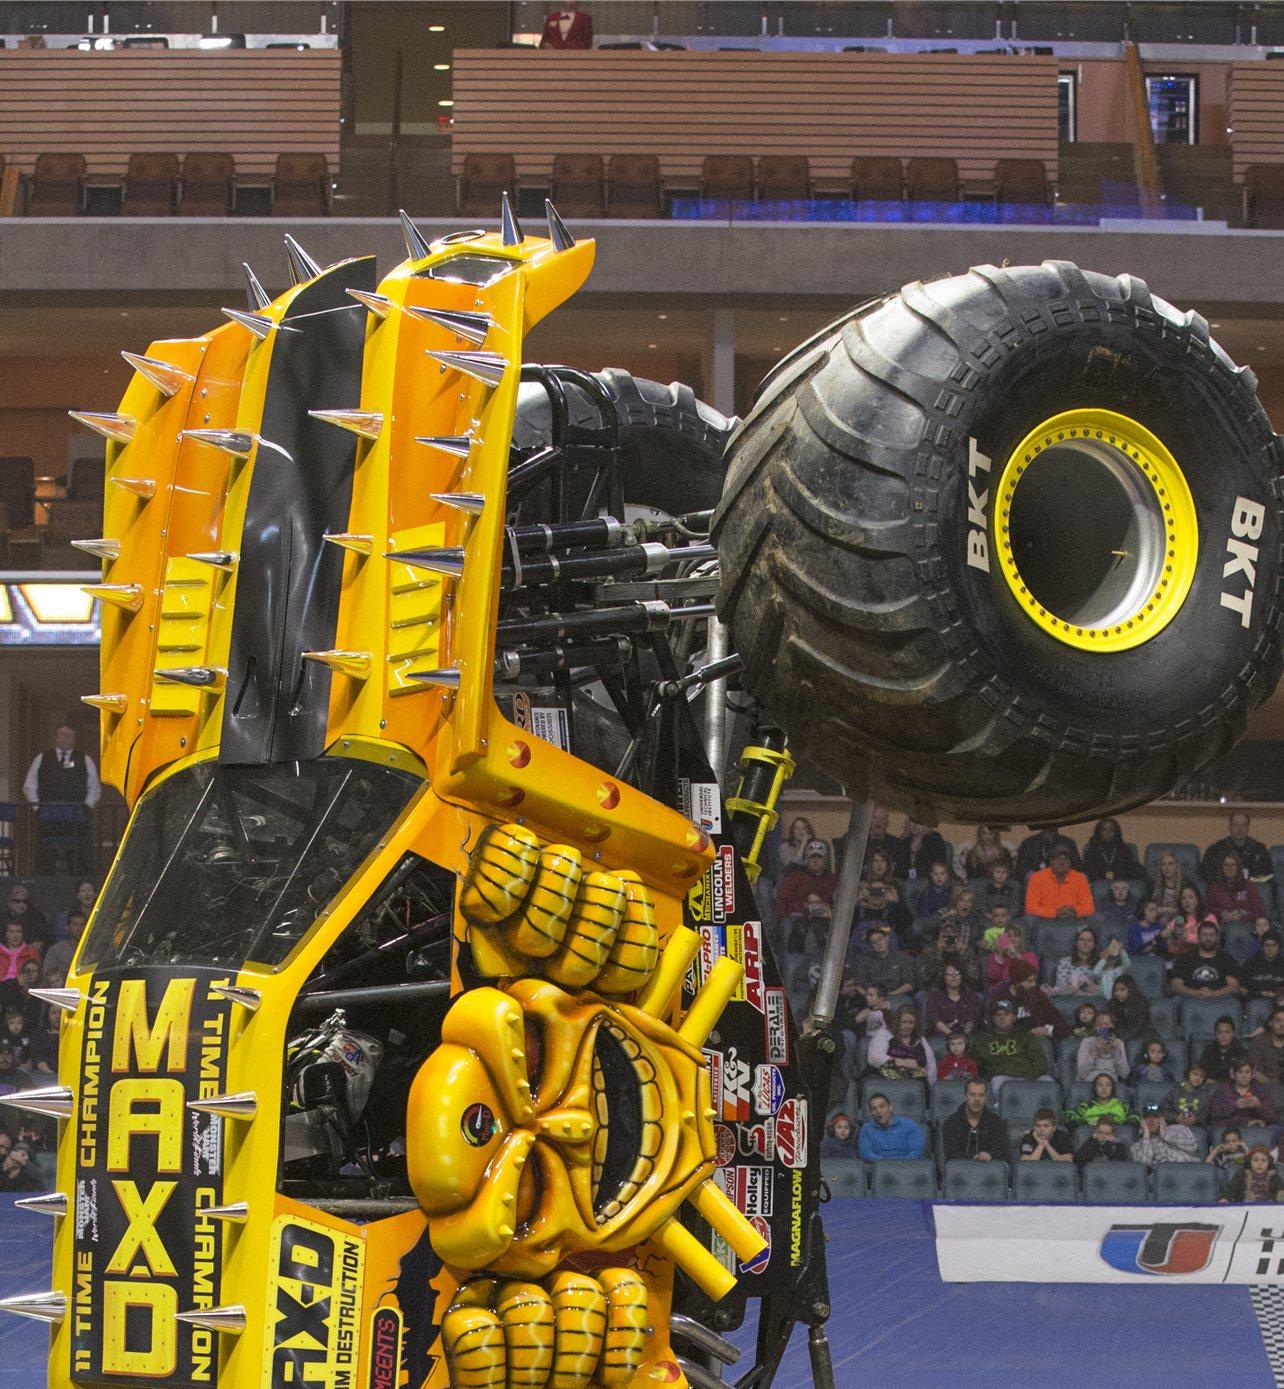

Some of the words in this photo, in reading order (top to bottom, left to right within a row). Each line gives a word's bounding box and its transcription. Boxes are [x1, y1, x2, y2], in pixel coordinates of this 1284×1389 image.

[966, 436, 992, 573] BKT
[1220, 495, 1266, 630] BKT
[703, 873, 711, 921] MECHANIX
[714, 859, 724, 920] LINCOLN
[724, 853, 732, 906] WELDERS
[207, 977, 231, 1000] 11
[743, 922, 762, 1010] ARP
[200, 1013, 224, 1100] TIME
[768, 995, 780, 1059] DERALE
[80, 980, 110, 1168] CHAMPION
[762, 1069, 770, 1108] LUCAS
[191, 1111, 202, 1144] World
[202, 1129, 210, 1161] JAM
[208, 1113, 220, 1176] MONSTER
[776, 1101, 795, 1166] JAZ
[78, 1179, 86, 1240] MONSTER
[746, 1167, 760, 1214] Holley
[790, 1169, 802, 1267] MAGNAFLOW
[75, 1251, 92, 1336] TIME
[191, 1187, 216, 1382] CHAMPON
[336, 1240, 360, 1364] DESTRUCTION
[75, 1349, 91, 1372] 11
